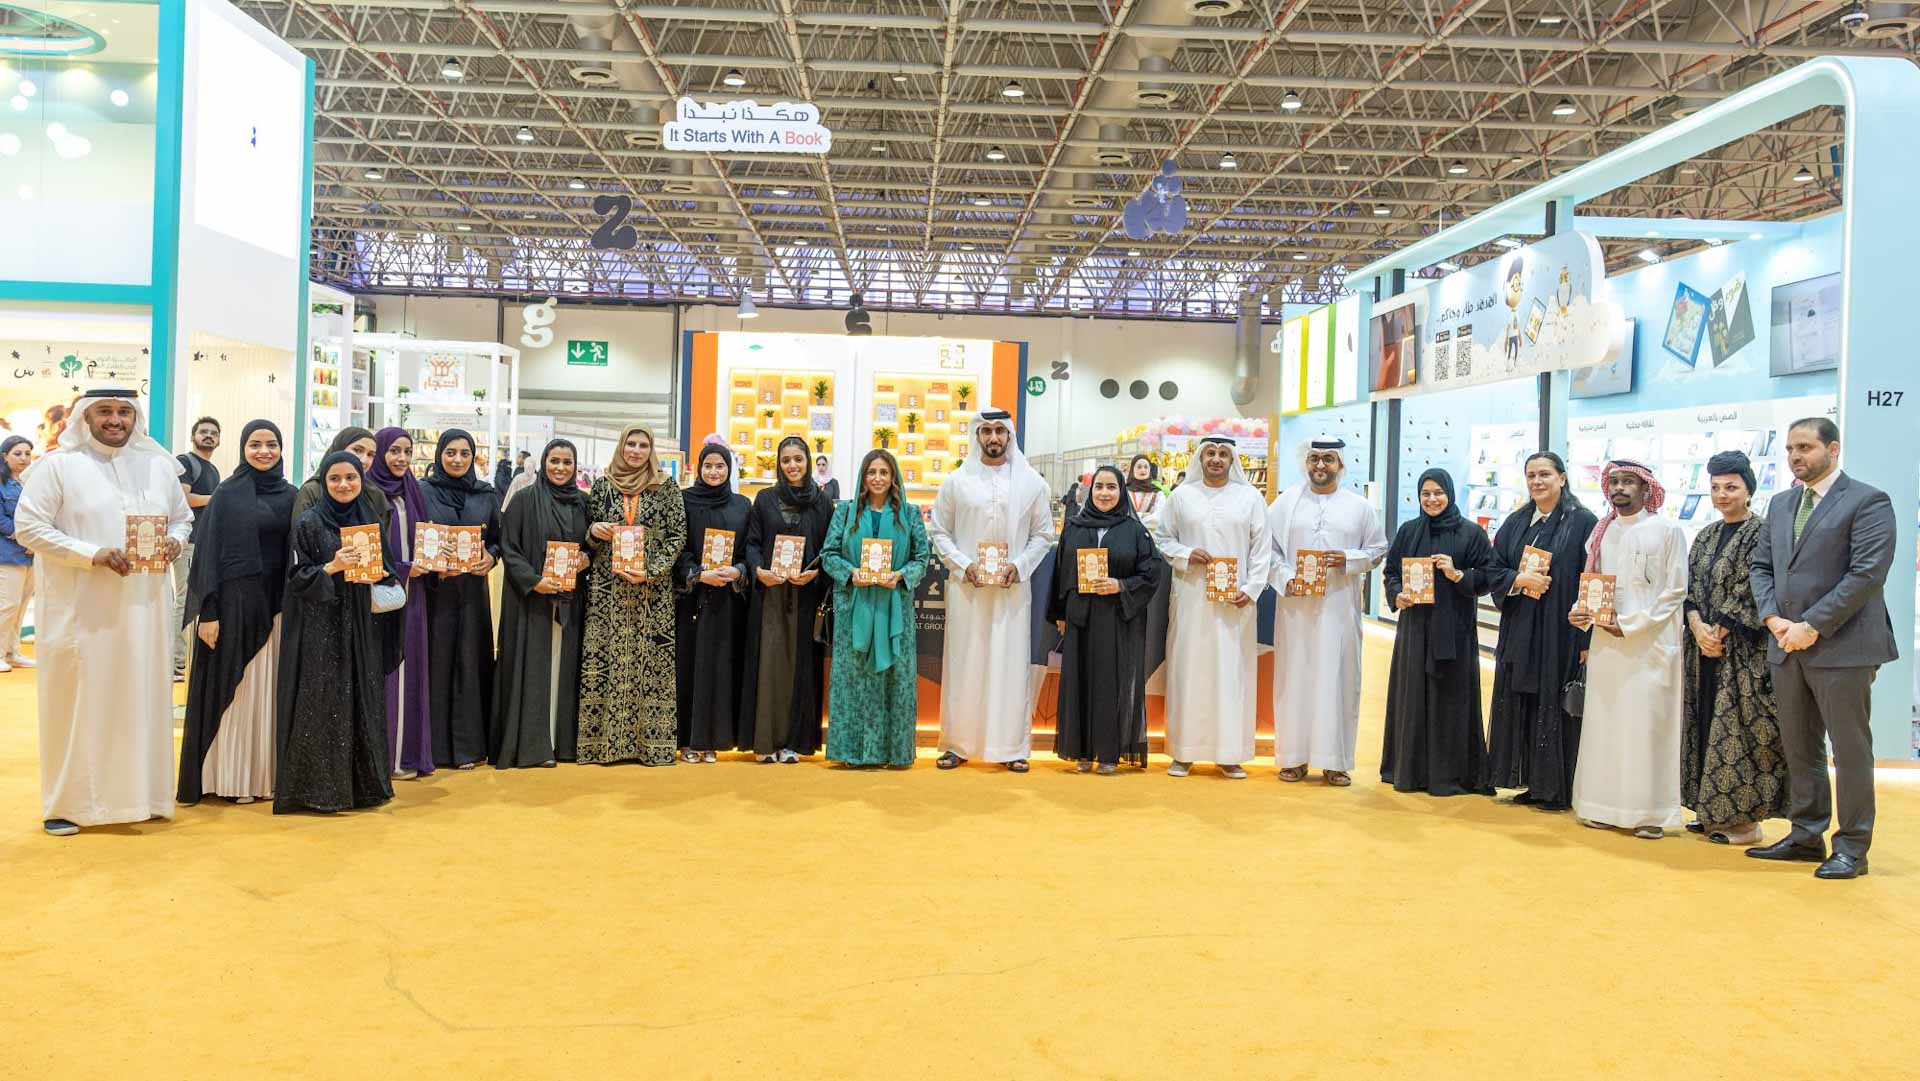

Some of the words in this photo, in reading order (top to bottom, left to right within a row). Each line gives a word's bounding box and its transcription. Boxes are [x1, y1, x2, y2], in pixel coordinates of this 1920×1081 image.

[741, 106, 809, 122] هكذا
[670, 128, 679, 142] It
[683, 128, 727, 143] Starts
[731, 130, 765, 144] With
[769, 131, 780, 144] A
[785, 131, 823, 145] Book
[1867, 390, 1904, 407] H27
